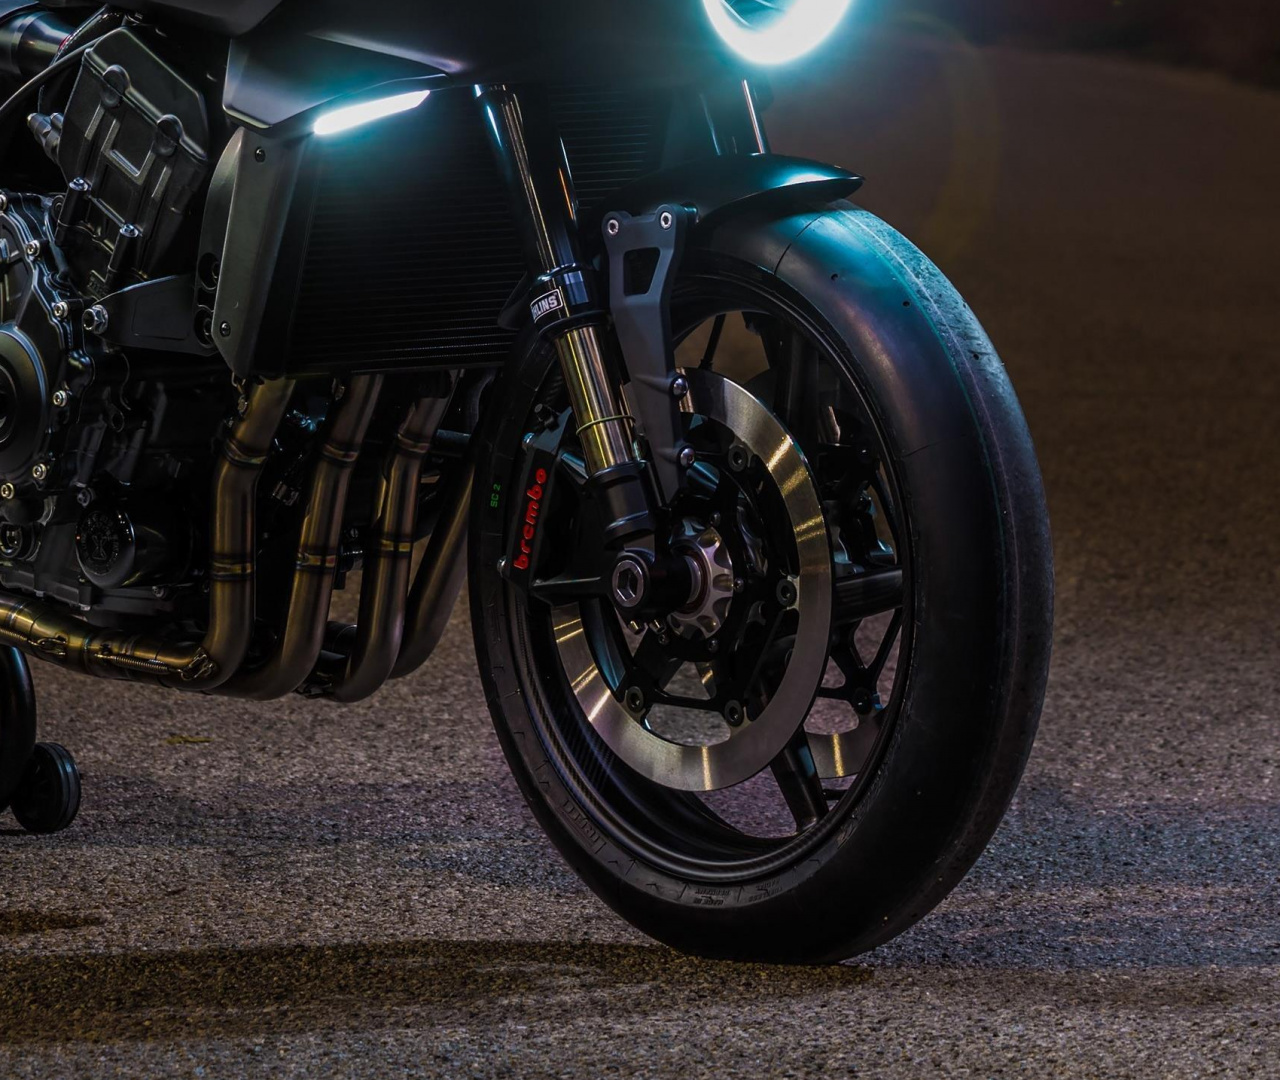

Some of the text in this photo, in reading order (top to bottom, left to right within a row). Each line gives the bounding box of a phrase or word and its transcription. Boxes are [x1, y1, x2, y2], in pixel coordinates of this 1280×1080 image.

[490, 483, 501, 508] SC 2
[513, 467, 548, 570] brembo
